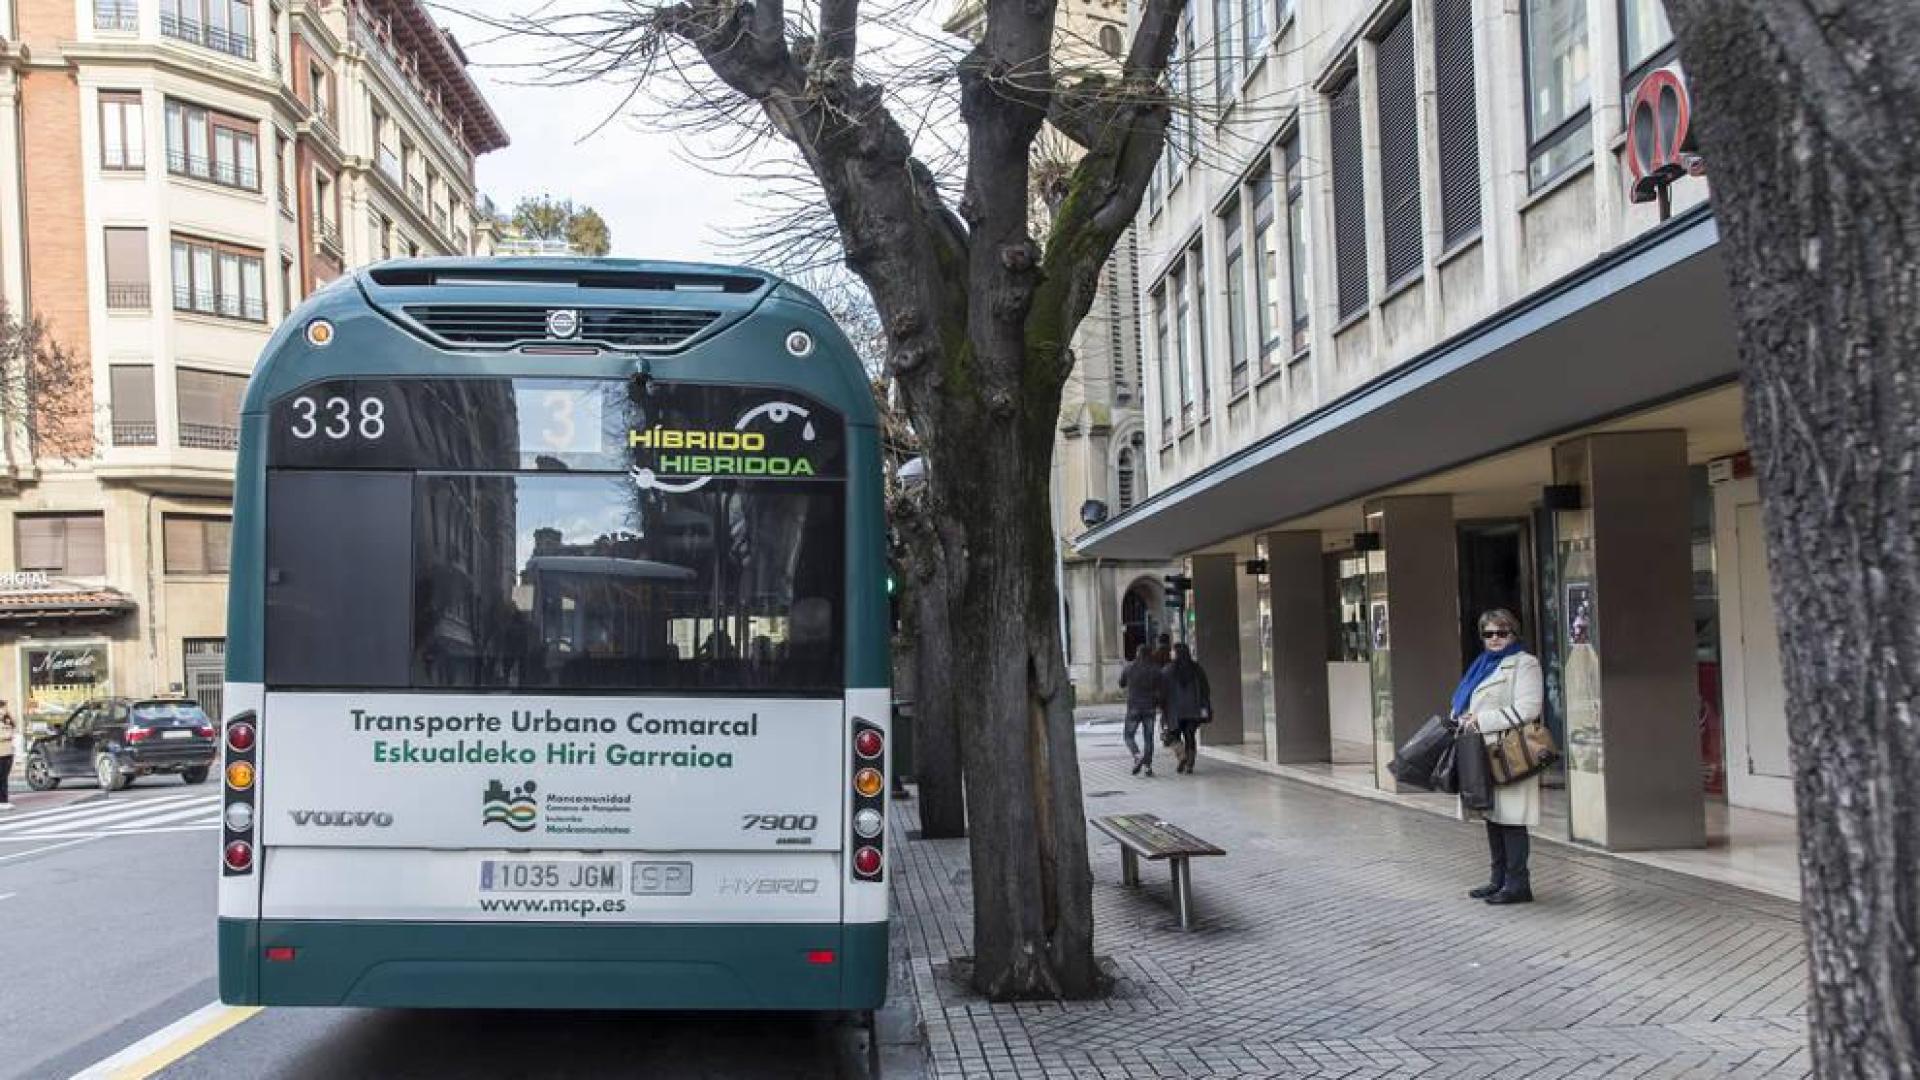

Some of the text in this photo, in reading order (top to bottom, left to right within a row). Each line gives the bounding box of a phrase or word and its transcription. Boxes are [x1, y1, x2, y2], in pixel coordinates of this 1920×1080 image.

[291, 397, 385, 440] 338
[542, 394, 576, 448] 3
[629, 424, 765, 451] HÍBRIDO
[660, 454, 815, 476] HIBRIDOA
[351, 709, 758, 737] Transporte Urbano Comarcal
[373, 740, 733, 769] Eskualdeko Hiri Garraioa
[289, 809, 394, 827] VOLVO
[742, 813, 818, 831] 7900
[501, 865, 616, 887] 1035 JGM
[719, 878, 819, 895] HYBRID
[480, 899, 626, 916] www.mcp.es
